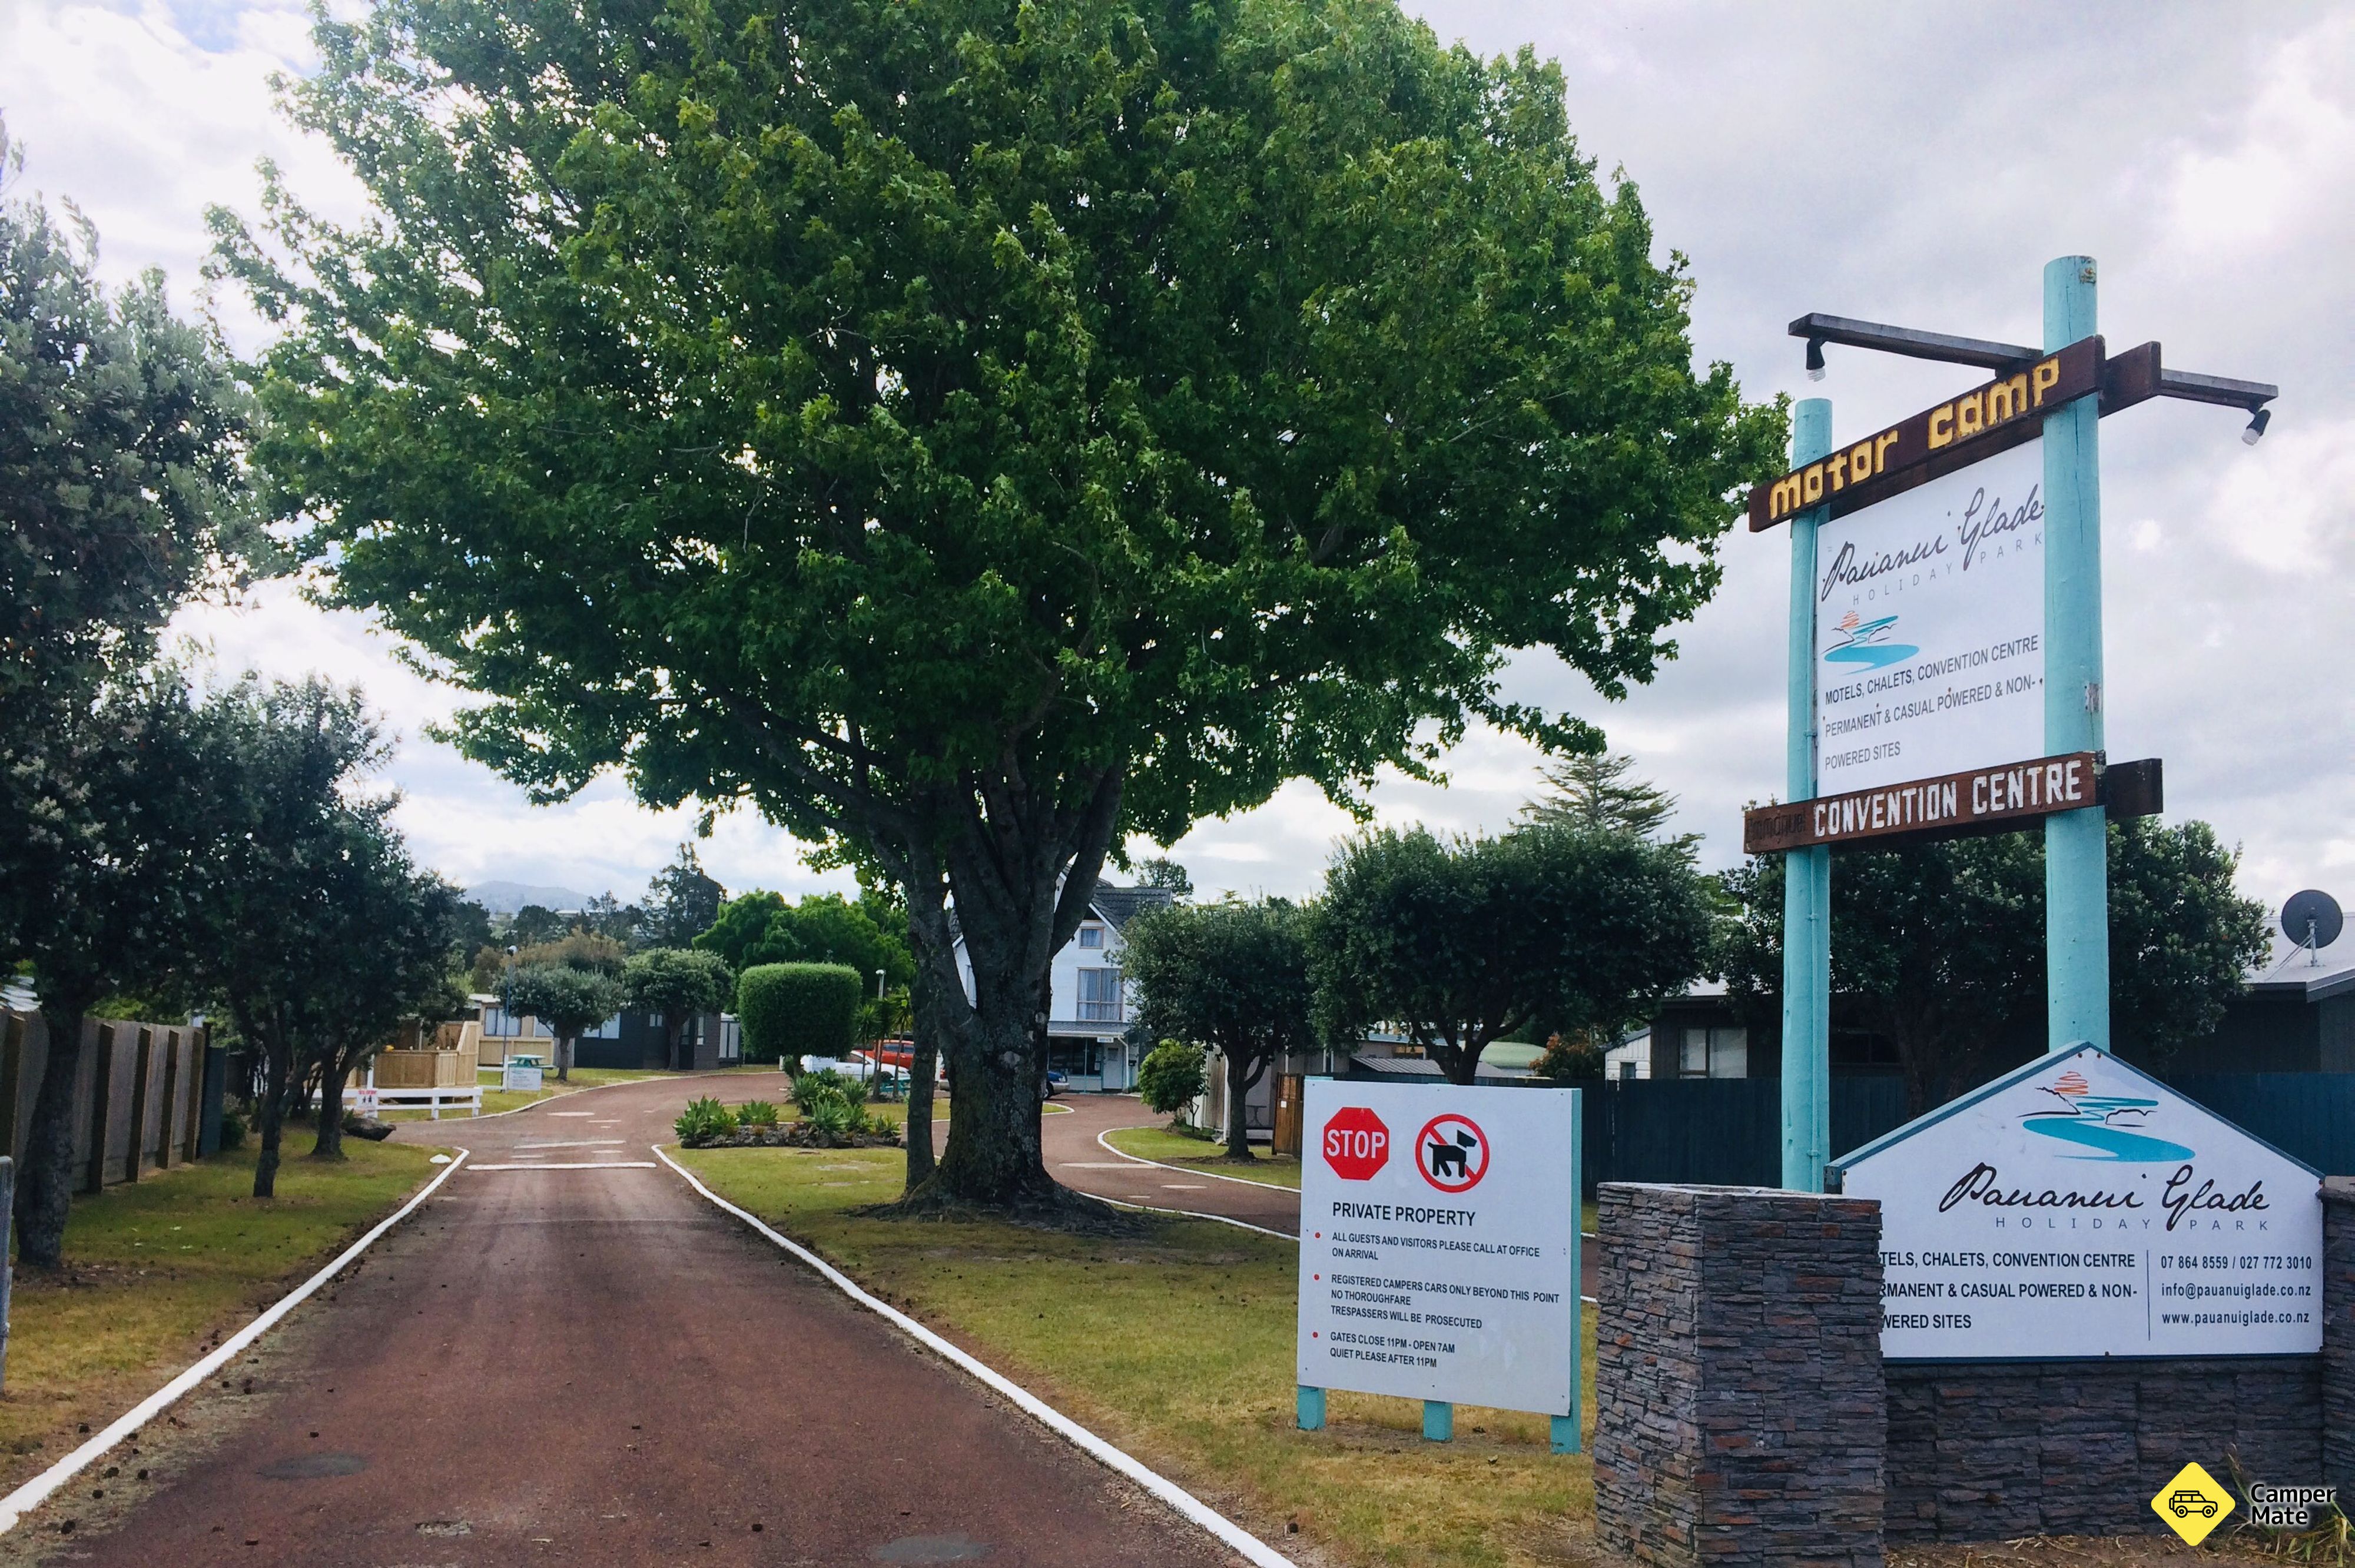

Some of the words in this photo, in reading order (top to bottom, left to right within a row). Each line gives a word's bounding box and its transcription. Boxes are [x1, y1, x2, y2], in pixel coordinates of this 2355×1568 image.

[1769, 429, 1899, 519] motor
[1928, 357, 2059, 450] camp
[1961, 483, 2044, 571] Glade
[1853, 563, 1953, 606] HOLIDAY
[1980, 532, 2042, 563] PARK
[1825, 682, 1864, 705] MOTELS,
[1867, 669, 1915, 694] CHALETS,
[1918, 648, 1988, 680] CONVENTION
[1991, 634, 2038, 662] CENTRE
[1825, 710, 1882, 738] PERMANENT
[1885, 709, 1891, 723] &
[1893, 698, 1935, 722] CASUAL
[1937, 684, 1992, 711] POWERED
[1995, 683, 2002, 697] &
[2006, 673, 2036, 695] NON-
[1825, 748, 1870, 770] POWERED
[1873, 742, 1900, 760] SITES
[1814, 781, 1957, 838] CONVENTION
[1972, 760, 2082, 816] CENTRE
[1326, 1130, 1386, 1158] STOP
[1939, 1162, 2147, 1212] Pauanui
[2161, 1164, 2270, 1231] Glade
[1333, 1202, 1391, 1220] PRIVATE
[1395, 1207, 1475, 1226] PROPERTY
[1996, 1217, 2151, 1229] HOLIDAY
[2190, 1220, 2268, 1230] PARK
[1332, 1233, 1346, 1242] ALL
[1349, 1233, 1380, 1244] GUESTS
[1382, 1236, 1398, 1246] AND
[1401, 1238, 1437, 1249] VISITORS
[1439, 1240, 1471, 1251] PLEASE
[1474, 1243, 1495, 1254] CALL
[1497, 1245, 1507, 1254] AT
[1509, 1245, 1540, 1257] OFFICE
[1332, 1248, 1343, 1257] ON
[1345, 1249, 1378, 1260] ARRIVAL
[1880, 1252, 1918, 1268] TELS,
[1922, 1253, 1988, 1268] CHALETS,
[1993, 1253, 2079, 1267] CONVENTION
[2083, 1254, 2135, 1267] CENTRE
[2161, 1256, 2174, 1268] 07
[2178, 1256, 2198, 1268] 864
[2202, 1256, 2228, 1269] 8559
[2240, 1256, 2259, 1269] 027
[2263, 1256, 2282, 1269] 772
[2287, 1256, 2311, 1269] 3010
[1331, 1290, 1342, 1299] NO
[1345, 1291, 1411, 1305] THOROUGHFARE
[1332, 1274, 1381, 1287] REGISTERED
[1384, 1279, 1422, 1291] CAMPERS
[1425, 1283, 1447, 1293] CARS
[1450, 1285, 1471, 1295] ONLY
[1473, 1287, 1508, 1298] BEYOND
[1510, 1290, 1529, 1301] THIS
[1534, 1293, 1559, 1303] POINT
[1880, 1283, 1943, 1297] RMANENT
[1948, 1283, 1957, 1297] &
[1961, 1283, 2015, 1297] CASUAL
[2019, 1284, 2084, 1298] POWERED
[2088, 1284, 2097, 1297] &
[2102, 1284, 2137, 1298] NON-
[2161, 1283, 2311, 1299] info@pauanuiglade.co.nz
[1331, 1305, 1388, 1320] TRESPASSERS
[1389, 1311, 1408, 1321] WILL
[1411, 1313, 1421, 1323] BE
[1425, 1315, 1482, 1328] PROSECUTED
[1883, 1315, 1929, 1328] WERED
[1933, 1315, 1971, 1328] SITES
[2162, 1311, 2309, 1327] www.pauanuiglade.co.nz
[1331, 1332, 1356, 1343] GATES
[1358, 1334, 1384, 1346] CLOSE
[1387, 1337, 1407, 1348] 11PM
[1413, 1340, 1435, 1351] OPEN
[1438, 1343, 1455, 1353] 7AM
[1330, 1348, 1354, 1358] QUIET
[1356, 1351, 1386, 1362] PLEASE
[1388, 1354, 1414, 1365] AFTER
[1417, 1357, 1437, 1367] 11PM
